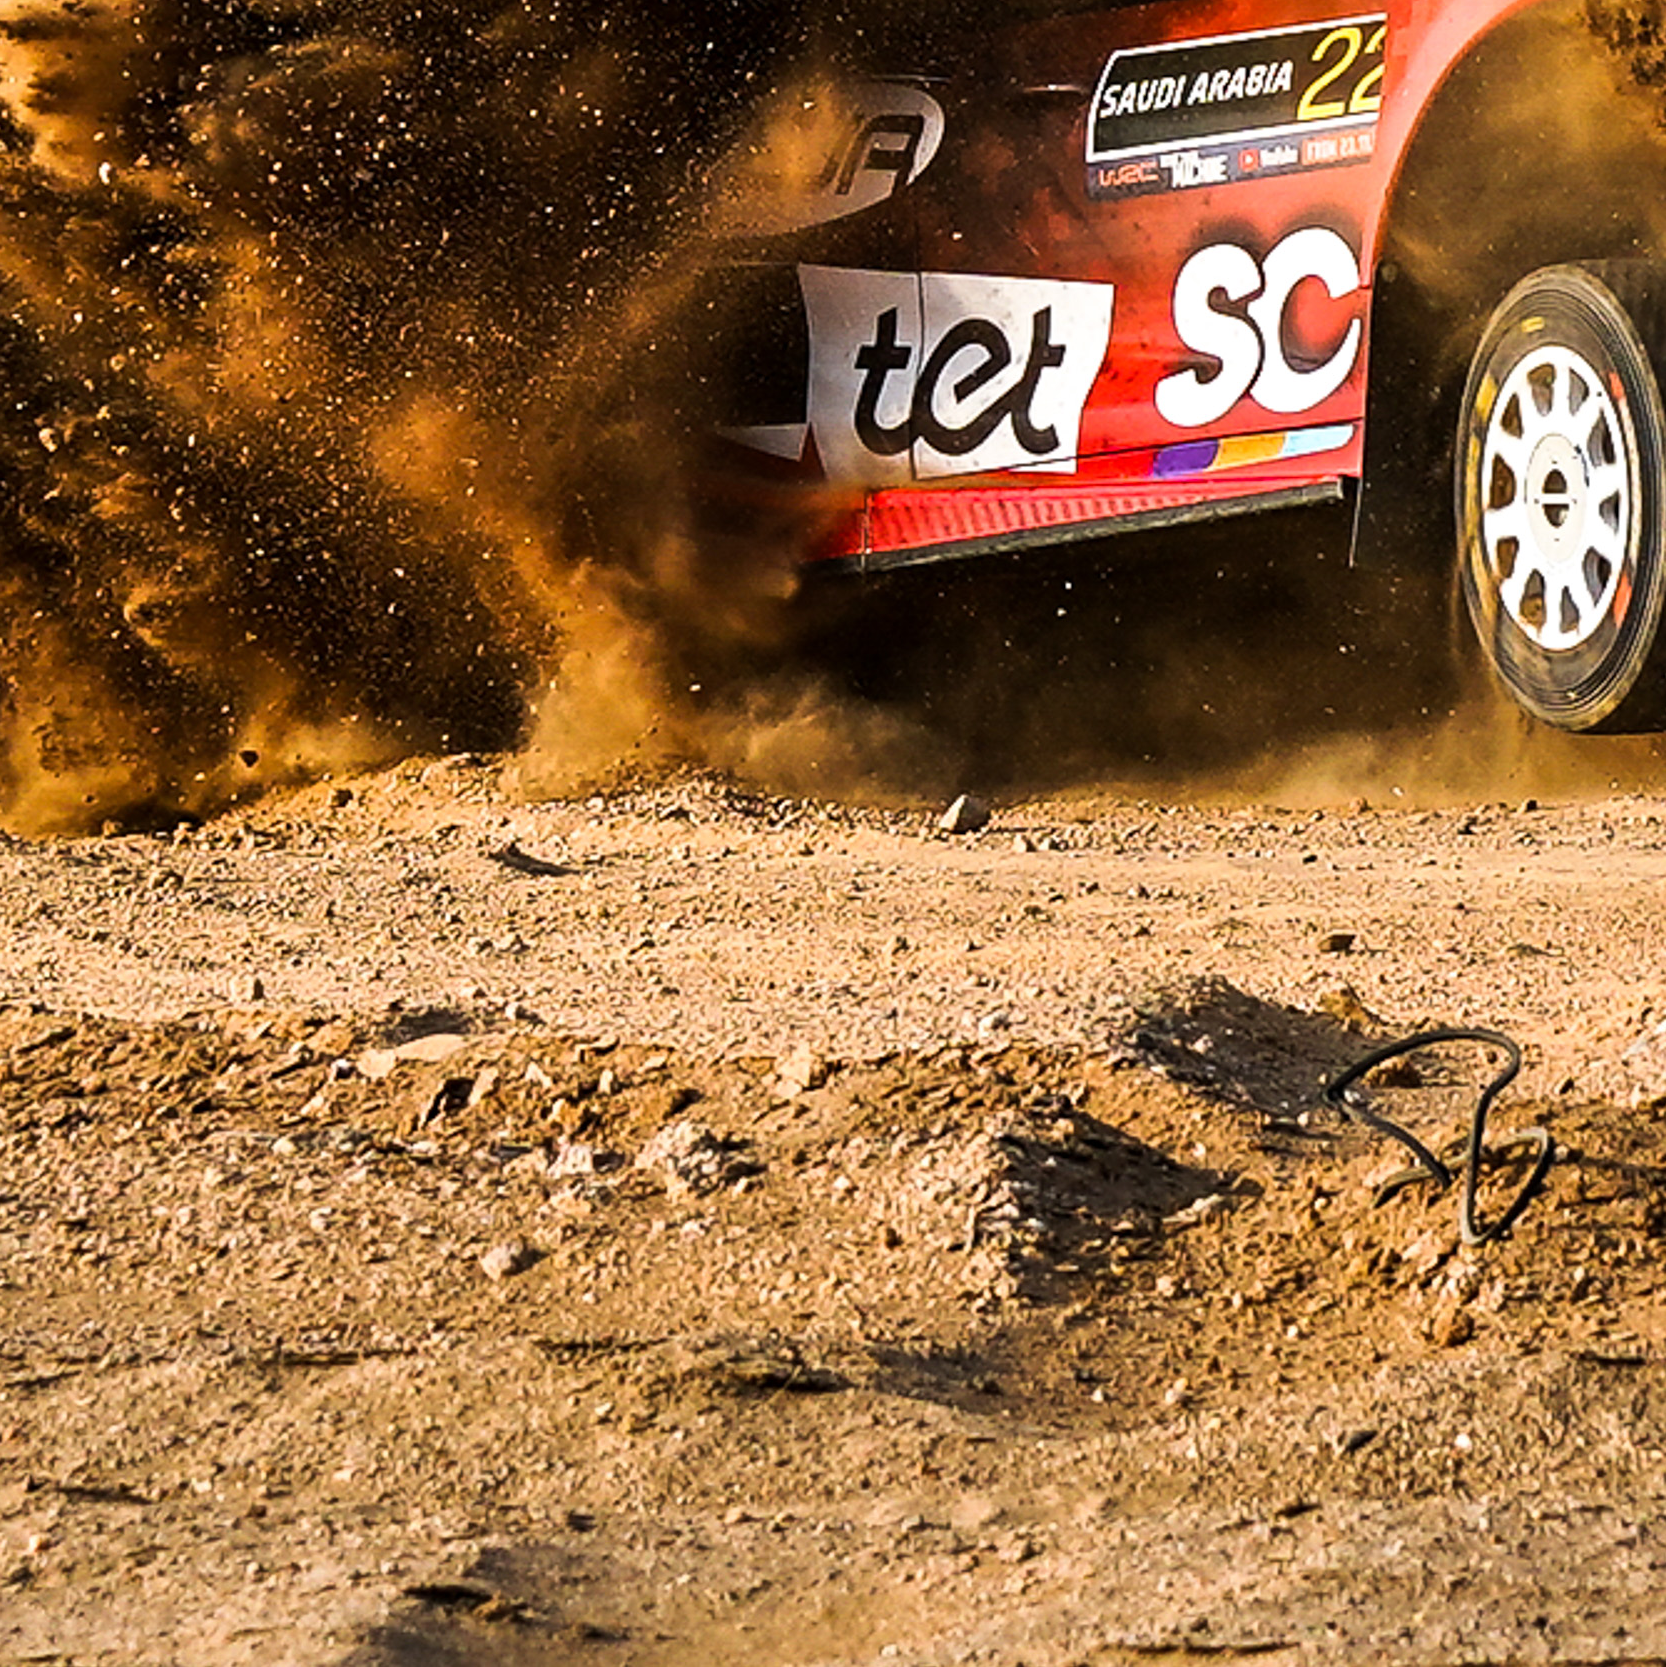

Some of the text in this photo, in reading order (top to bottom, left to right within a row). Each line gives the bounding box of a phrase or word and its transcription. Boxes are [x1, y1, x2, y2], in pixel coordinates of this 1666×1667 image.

[1100, 75, 1186, 118] SAUDI
[1188, 60, 1293, 105] ARABIA
[853, 306, 1066, 455] tet
[1154, 227, 1362, 427] SC
